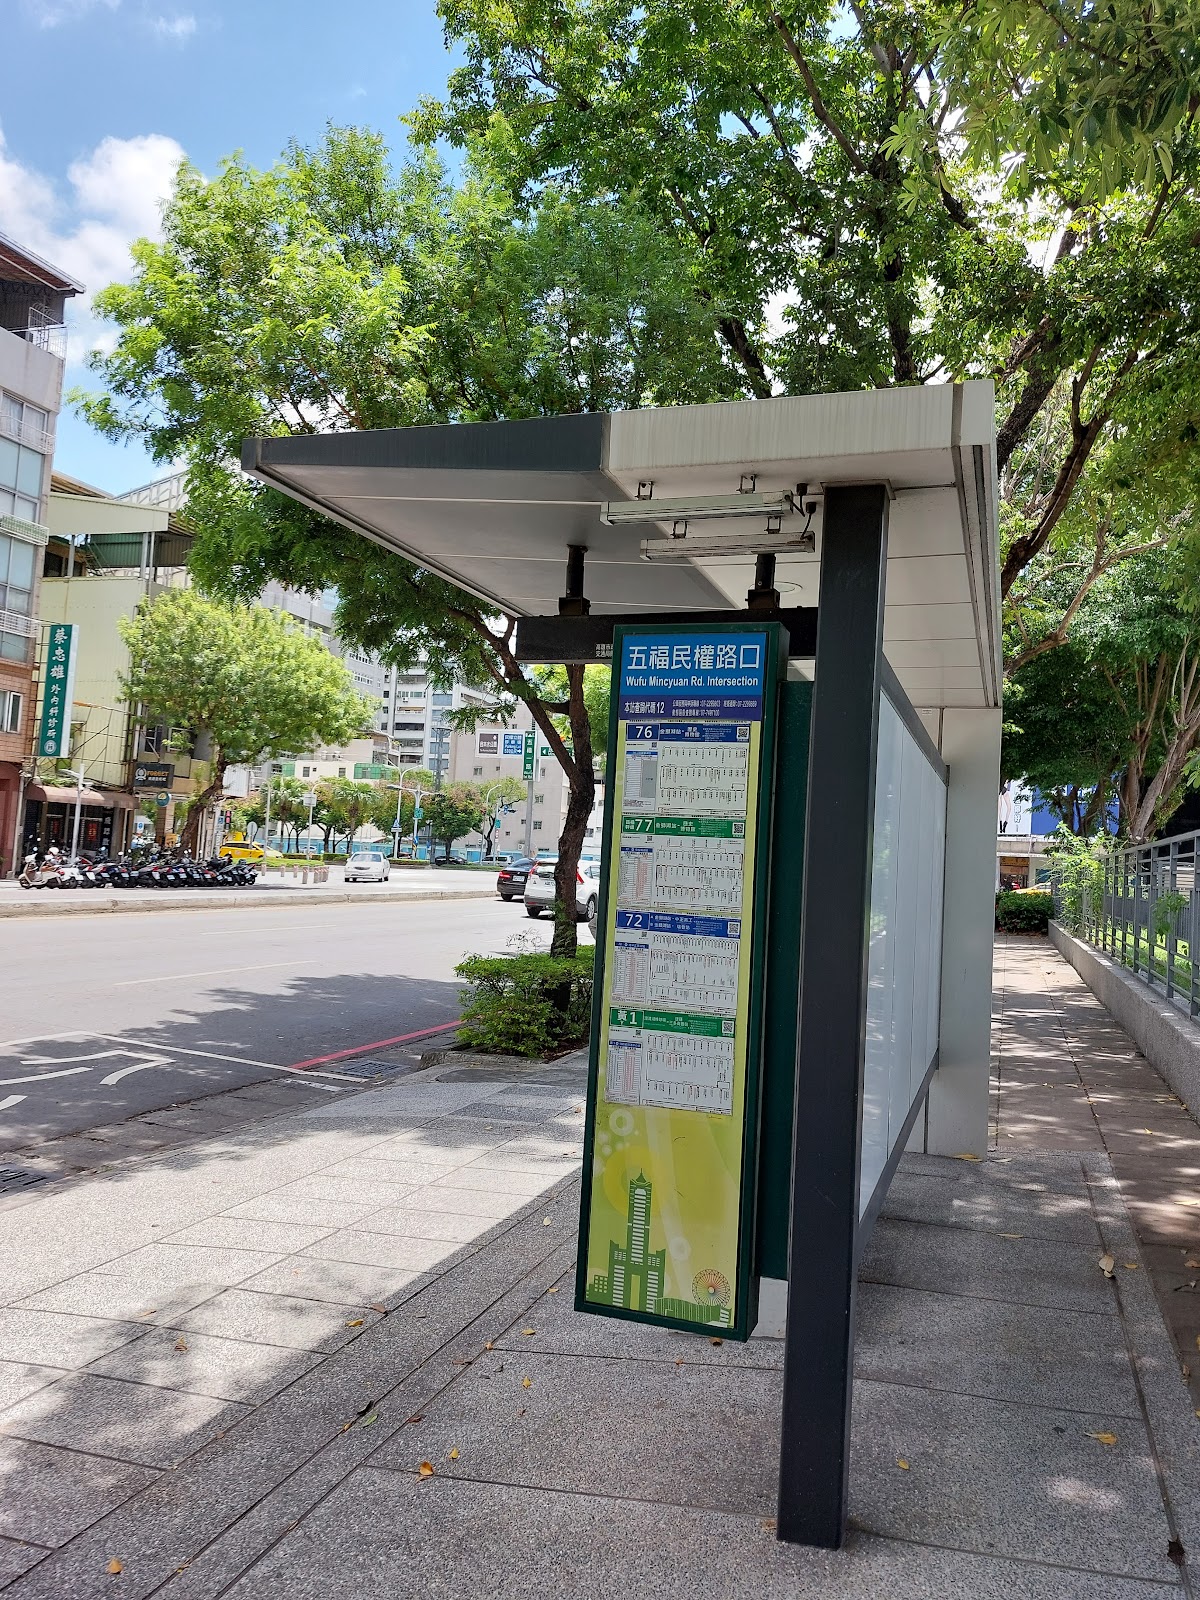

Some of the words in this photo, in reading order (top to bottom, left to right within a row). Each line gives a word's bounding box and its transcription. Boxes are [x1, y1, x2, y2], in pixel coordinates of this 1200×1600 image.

[50, 627, 68, 680] 蔡忠雄
[627, 644, 760, 670] 五福民權路口
[626, 675, 647, 687] Wufu
[648, 675, 689, 689] Mincyuan
[690, 675, 705, 687] Rd.
[707, 675, 758, 687] Intersection
[656, 702, 665, 714] 12
[635, 725, 653, 739] 76
[635, 819, 653, 832] 77
[625, 913, 642, 927] 72
